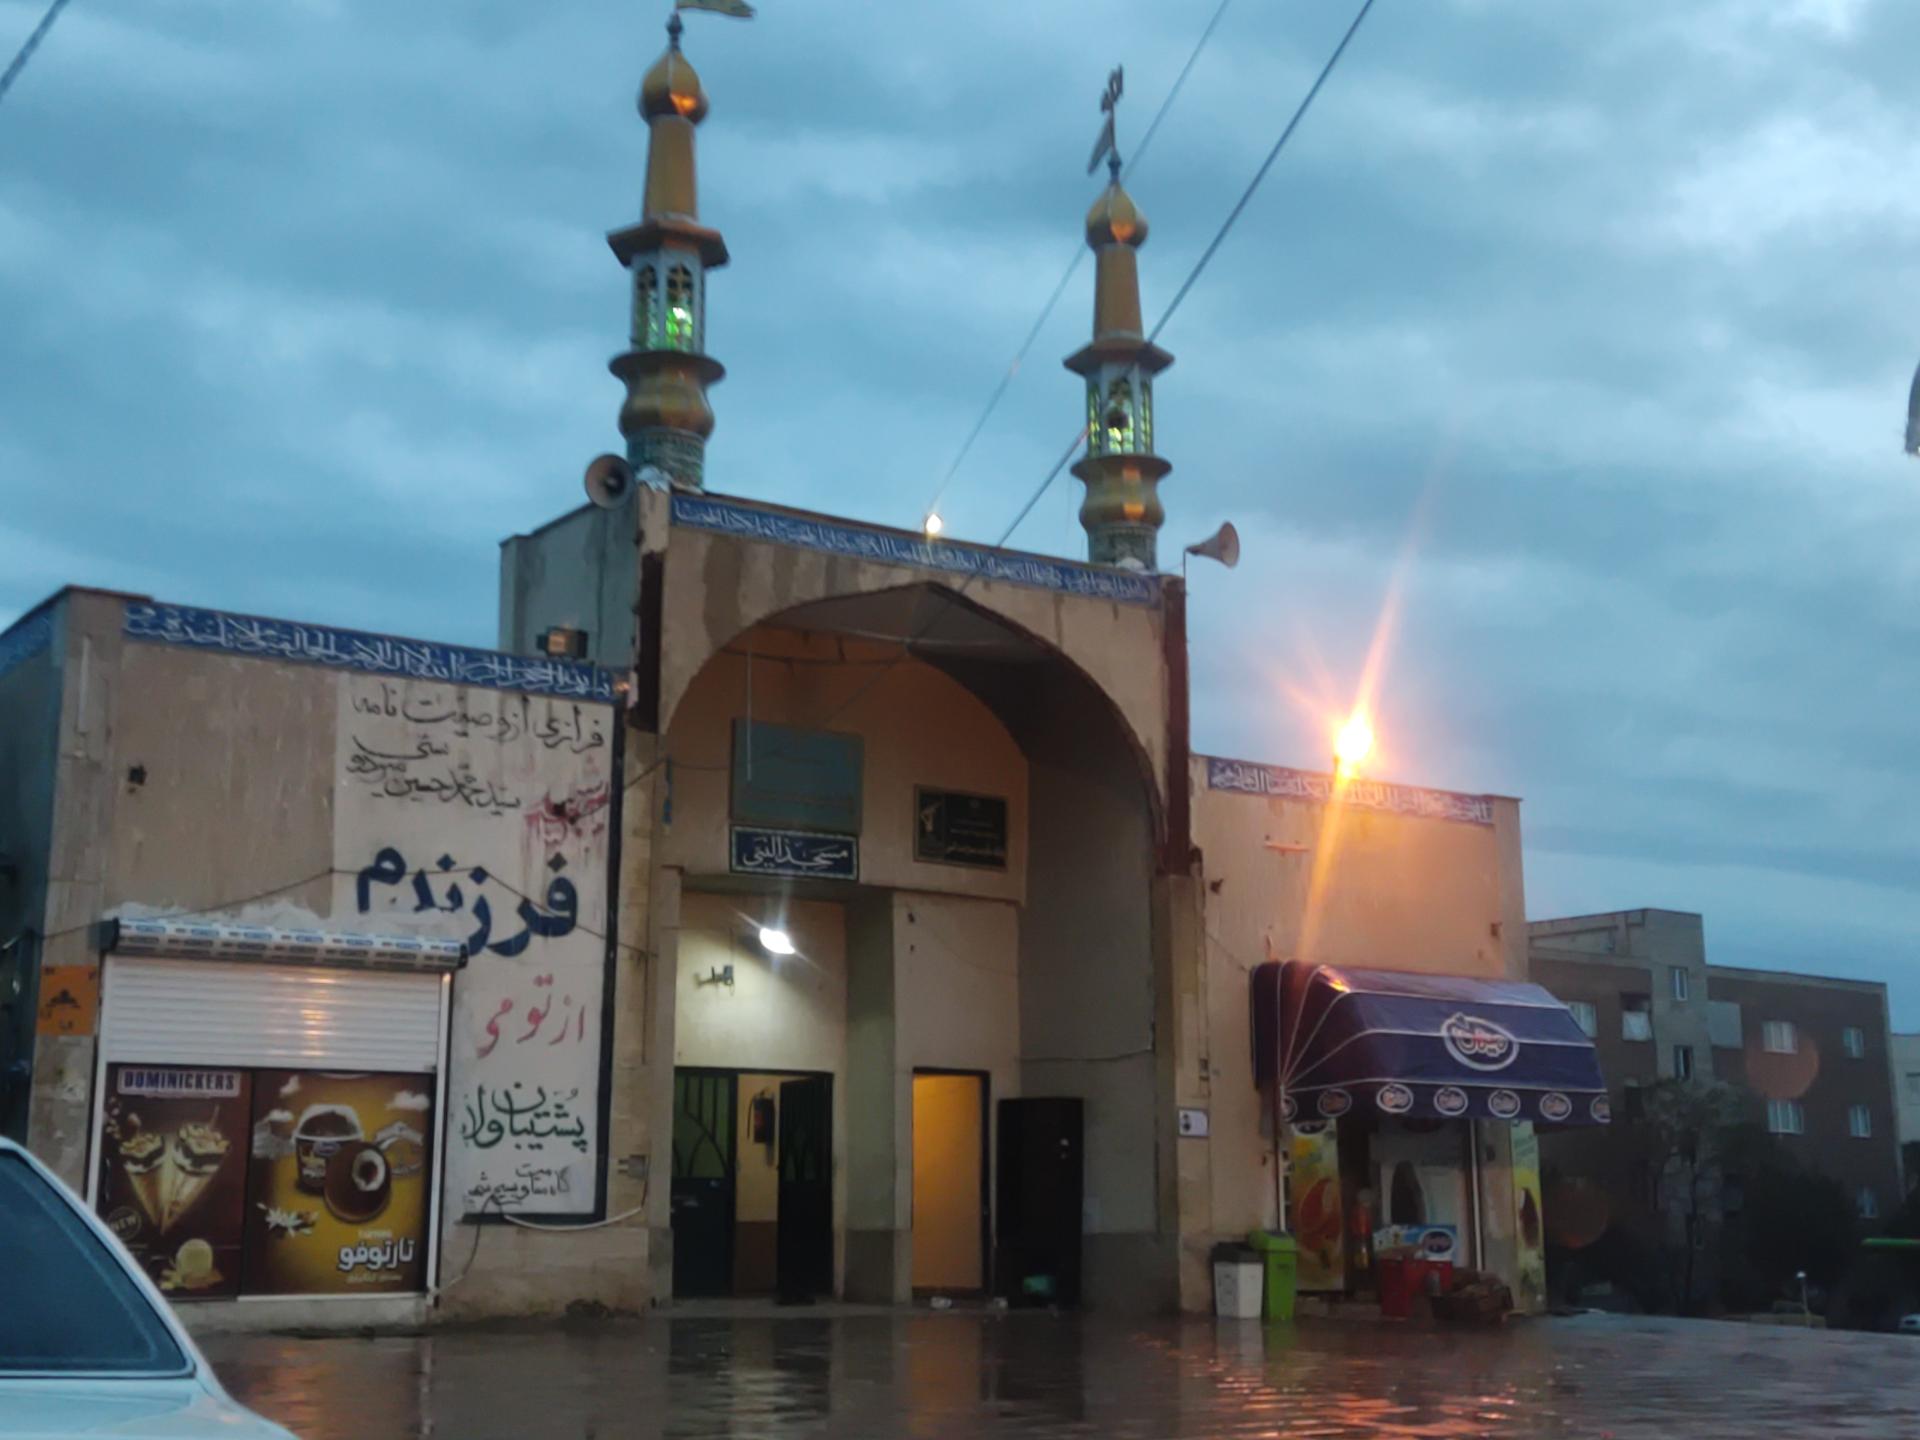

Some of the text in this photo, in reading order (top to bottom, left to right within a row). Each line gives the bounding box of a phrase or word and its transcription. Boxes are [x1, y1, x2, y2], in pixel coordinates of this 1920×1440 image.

[356, 846, 578, 958] فرزندم
[124, 1070, 235, 1091] DOMINICKERS
[337, 1236, 416, 1272] تارتوفو
